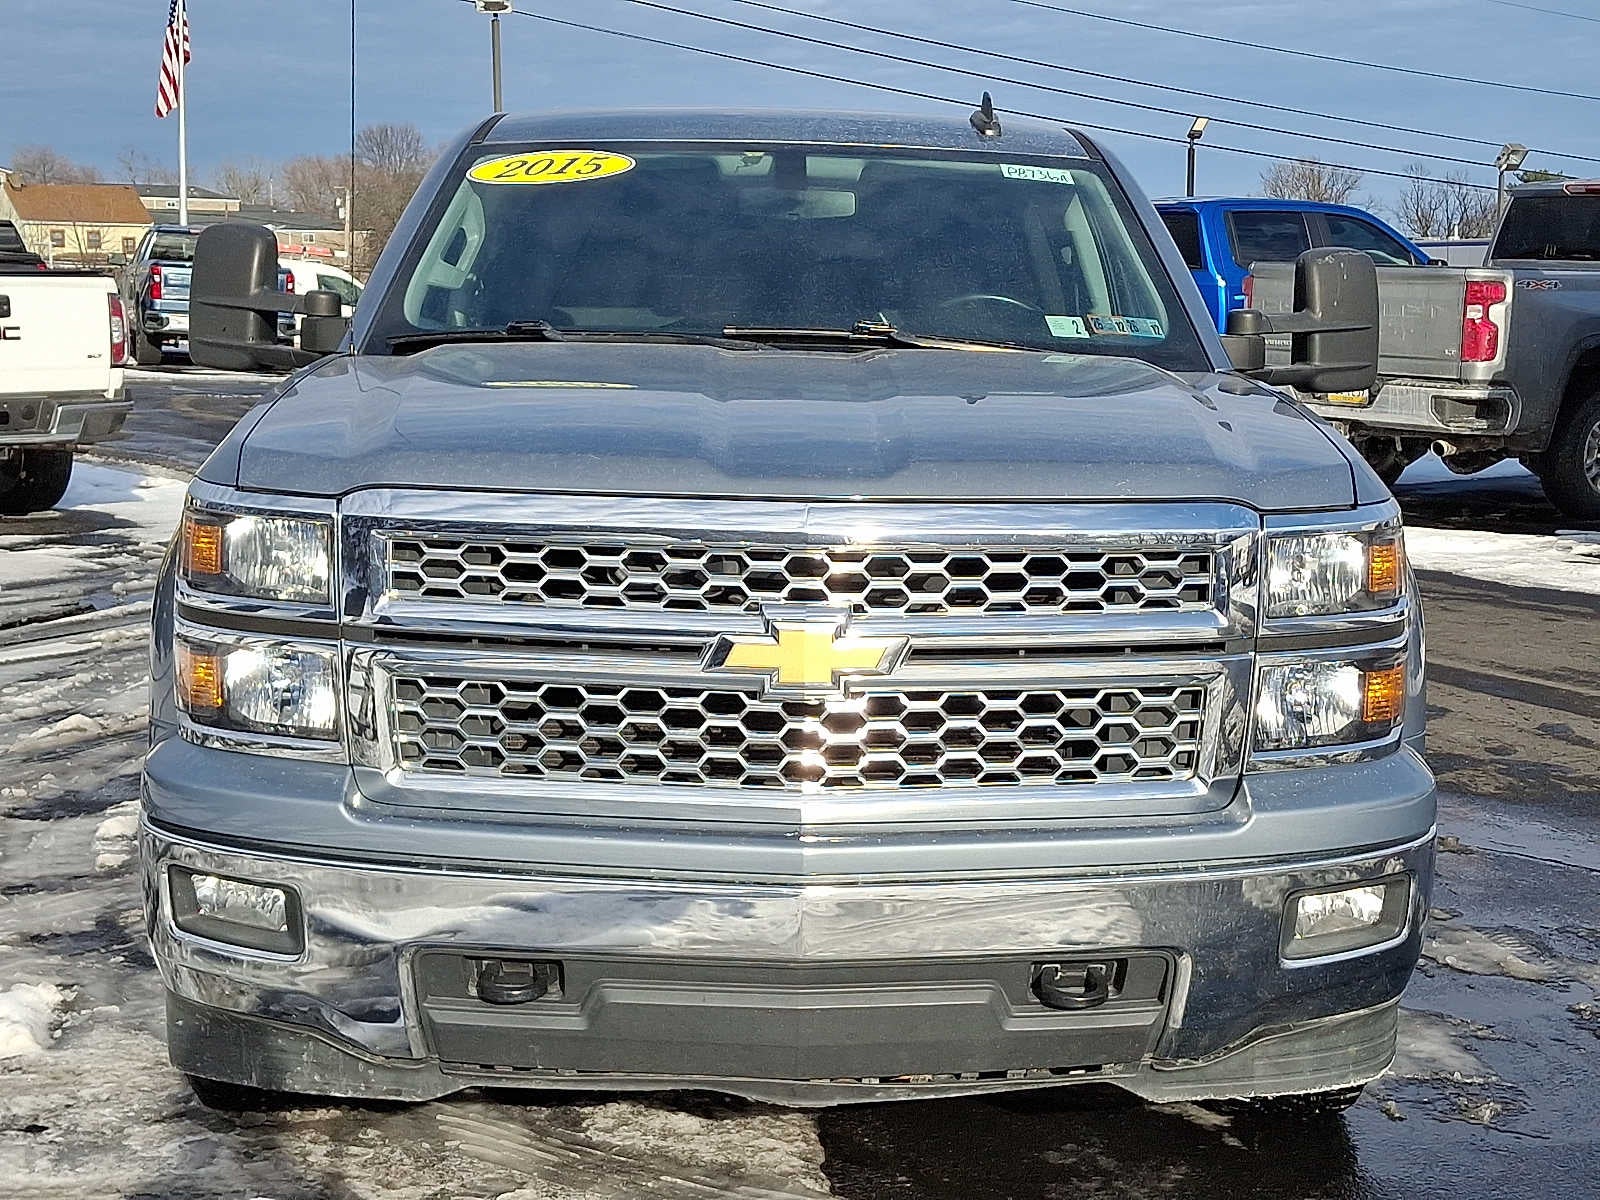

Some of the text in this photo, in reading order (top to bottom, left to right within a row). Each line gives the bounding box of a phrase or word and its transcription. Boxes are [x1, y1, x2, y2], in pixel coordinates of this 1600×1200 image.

[493, 156, 611, 179] 2015
[1071, 319, 1082, 335] 2
[1114, 321, 1127, 333] 12
[1150, 323, 1163, 336] 12
